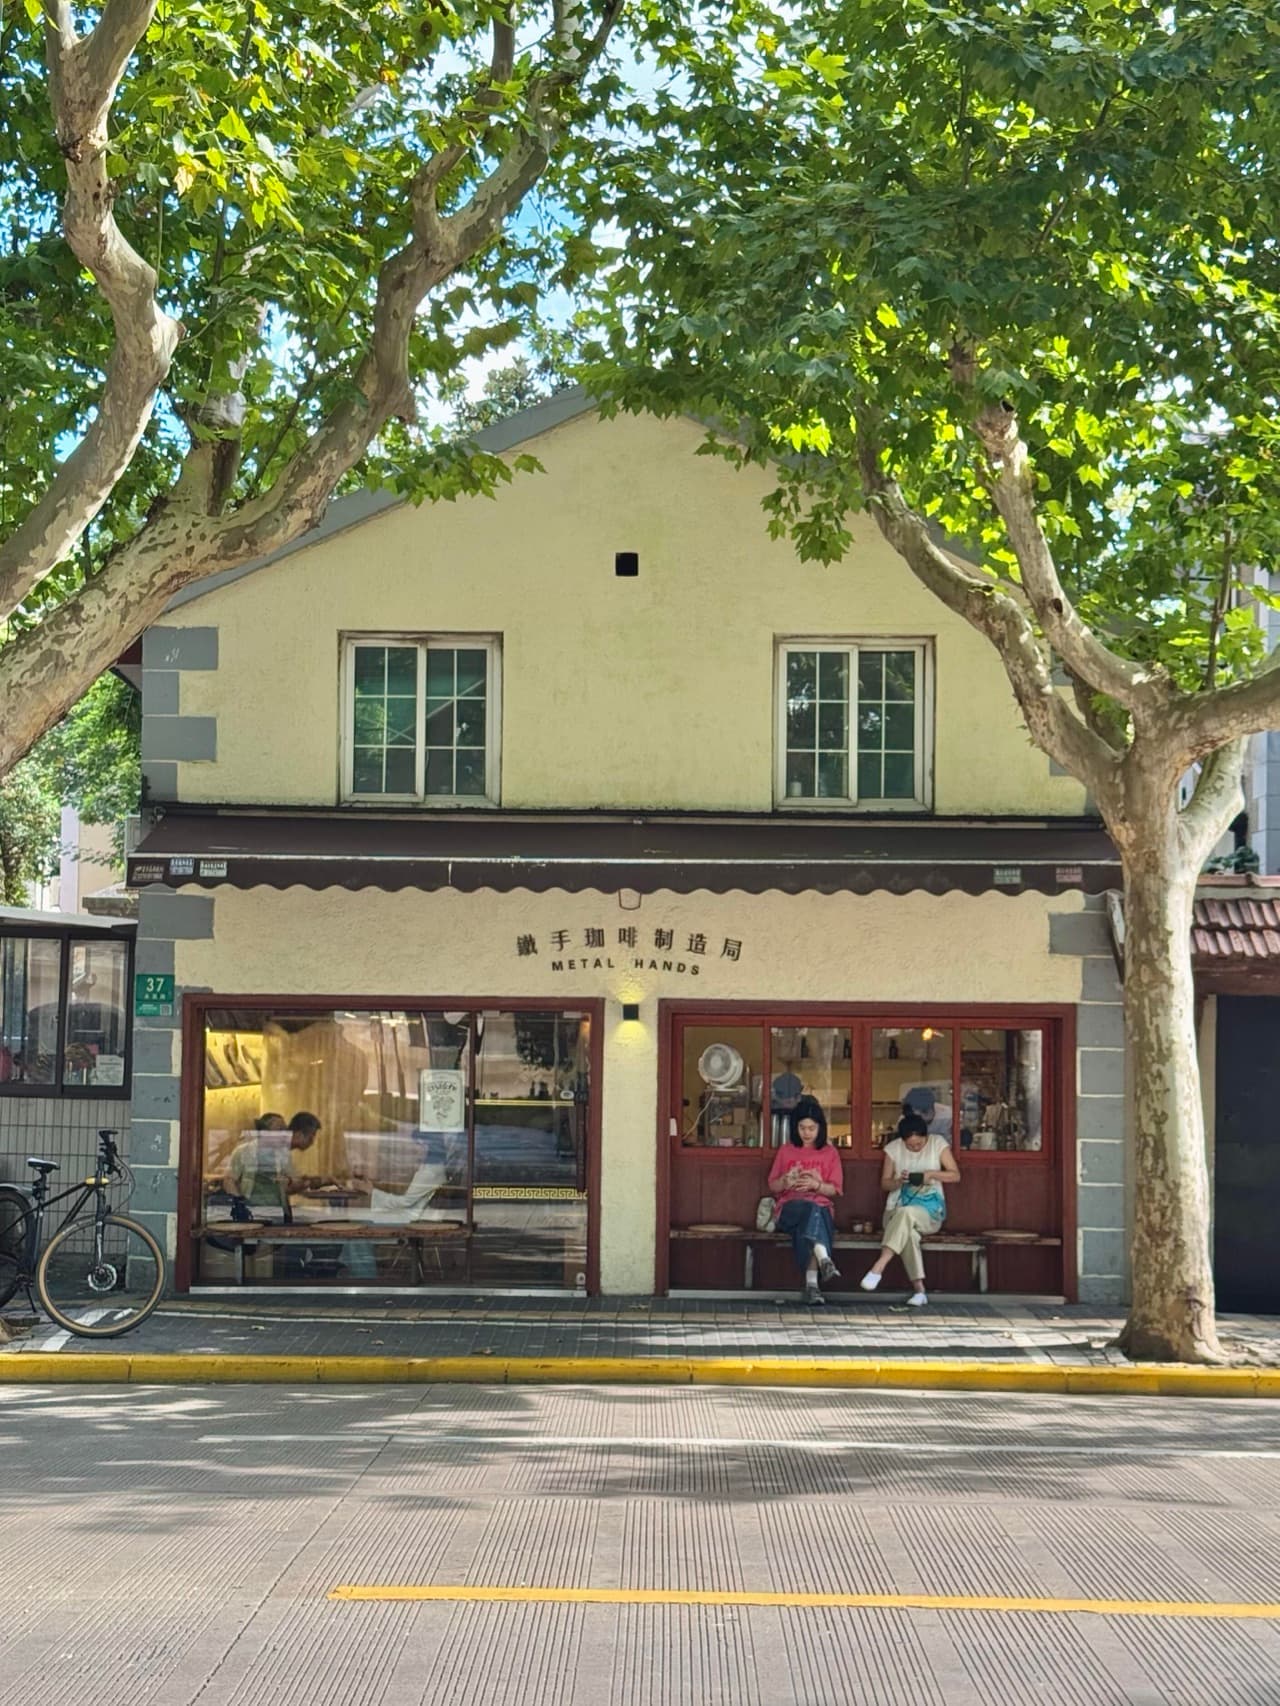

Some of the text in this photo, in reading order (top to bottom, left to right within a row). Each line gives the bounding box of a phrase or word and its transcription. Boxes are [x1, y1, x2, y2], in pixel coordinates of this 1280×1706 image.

[551, 958, 700, 976] METAL HANDS
[146, 977, 164, 992] 37
